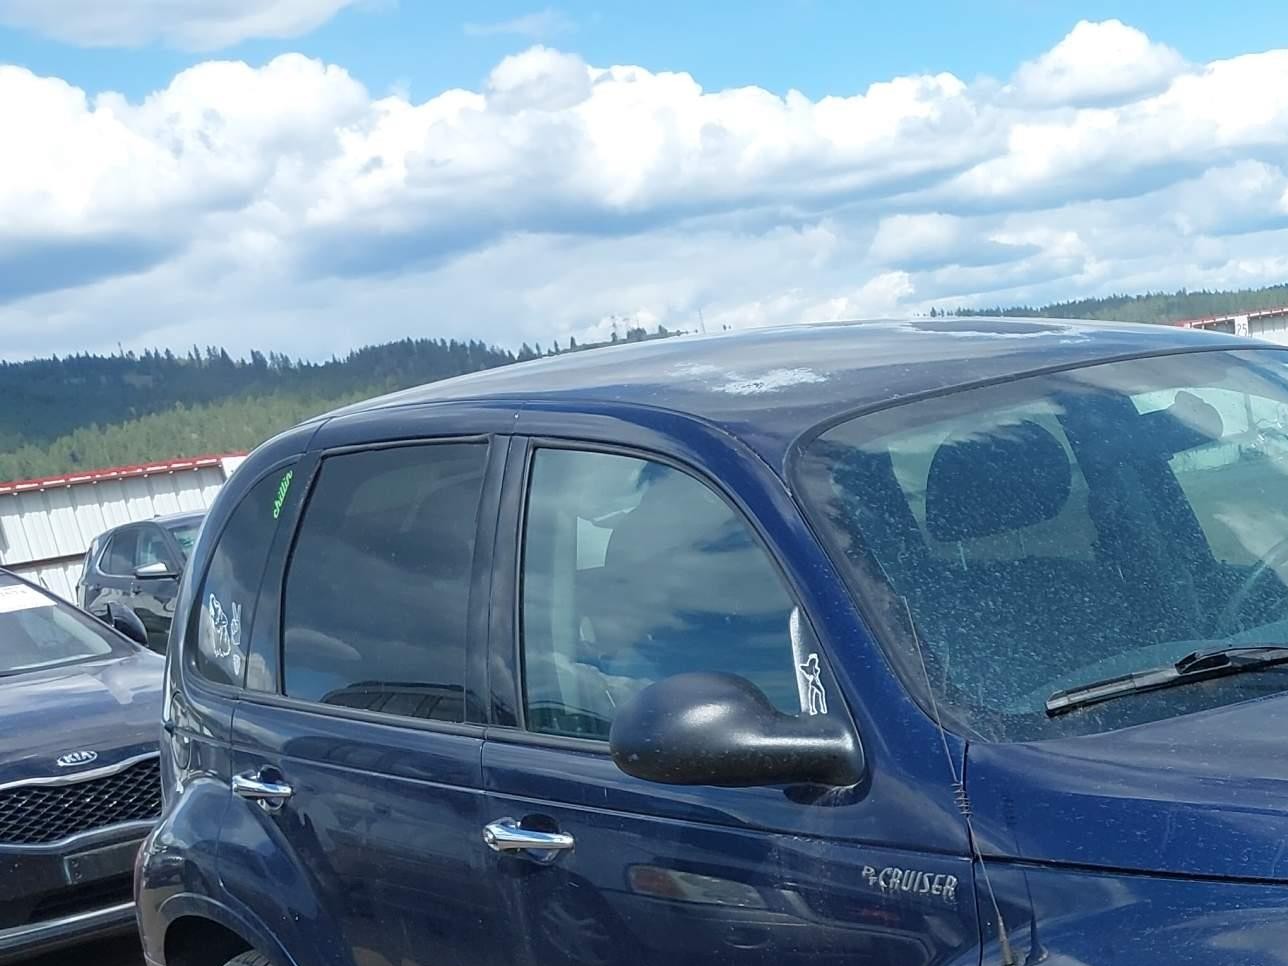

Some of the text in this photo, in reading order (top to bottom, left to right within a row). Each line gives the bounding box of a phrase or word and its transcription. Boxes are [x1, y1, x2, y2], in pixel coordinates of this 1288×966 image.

[1237, 323, 1248, 337] 25
[59, 751, 96, 765] KIA
[878, 867, 958, 897] CRUISER
